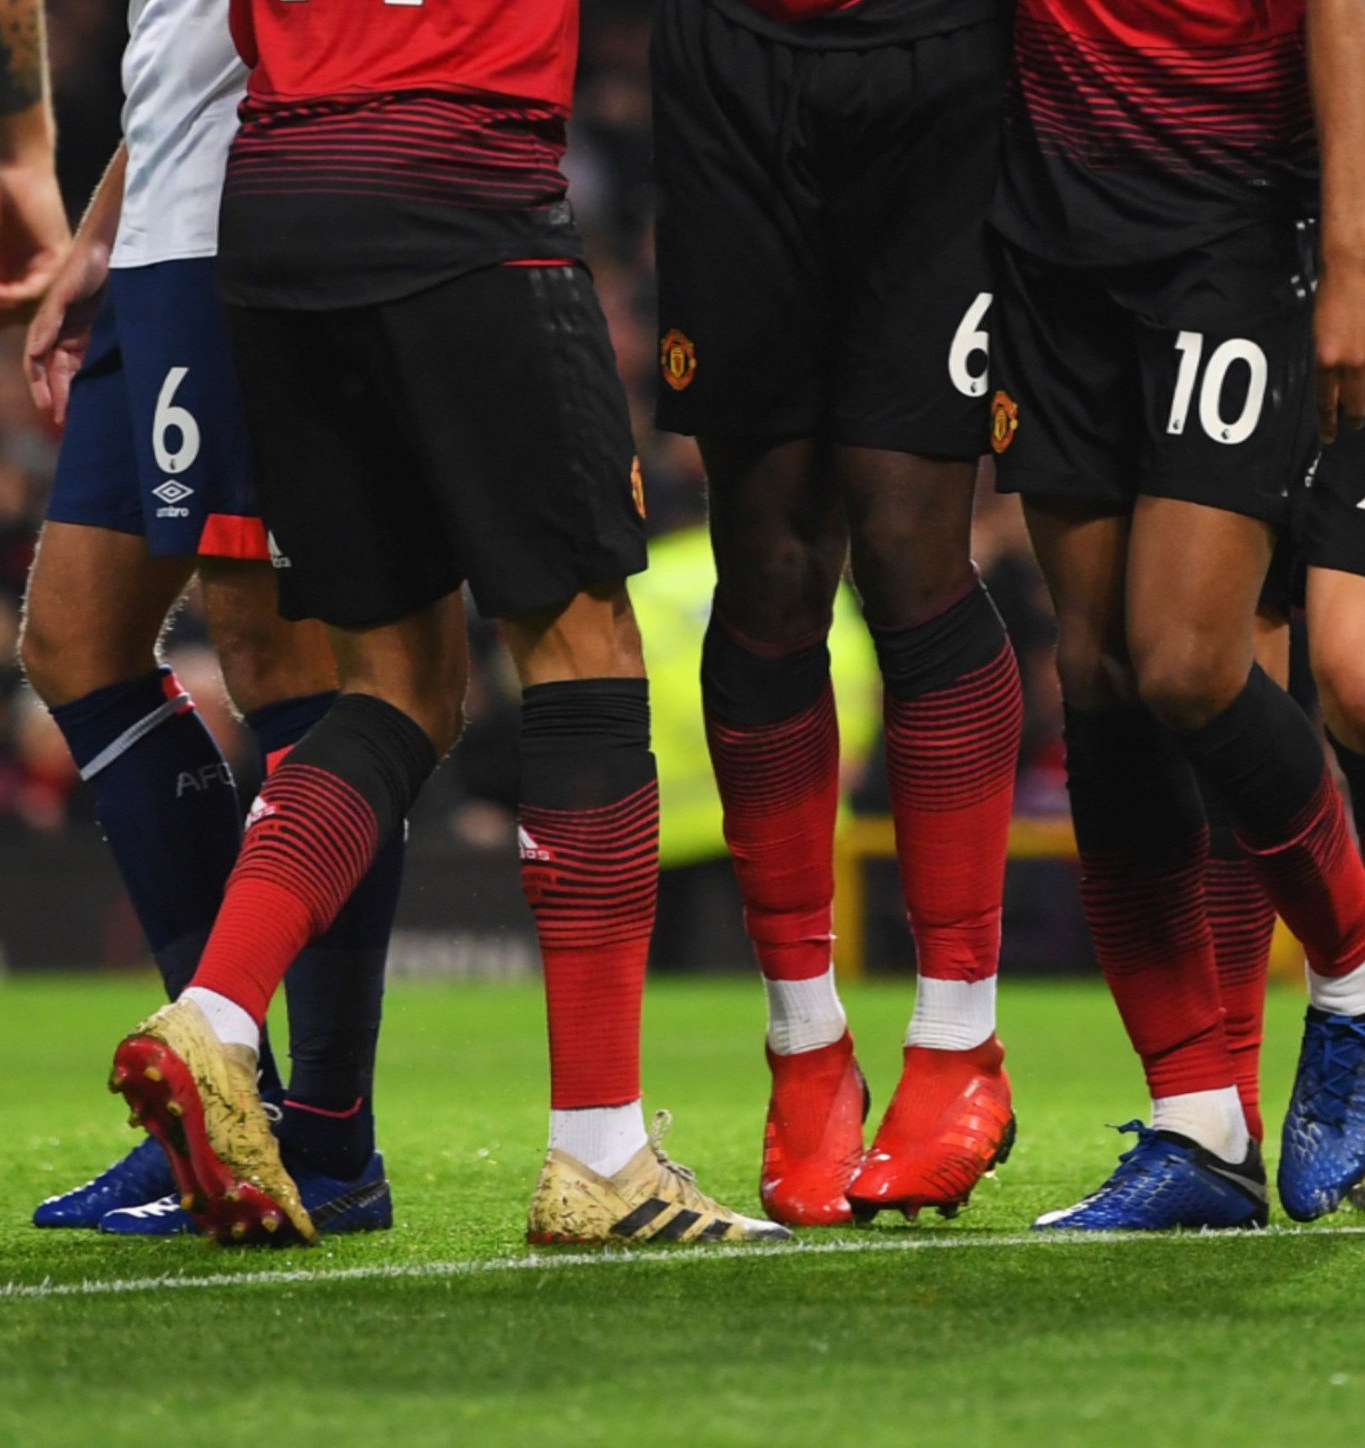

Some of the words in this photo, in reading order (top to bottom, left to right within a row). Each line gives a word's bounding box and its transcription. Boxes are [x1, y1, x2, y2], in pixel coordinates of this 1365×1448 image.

[948, 292, 993, 397] 6
[1166, 330, 1268, 444] 10
[152, 366, 201, 474] 6
[176, 761, 236, 797] AFC
